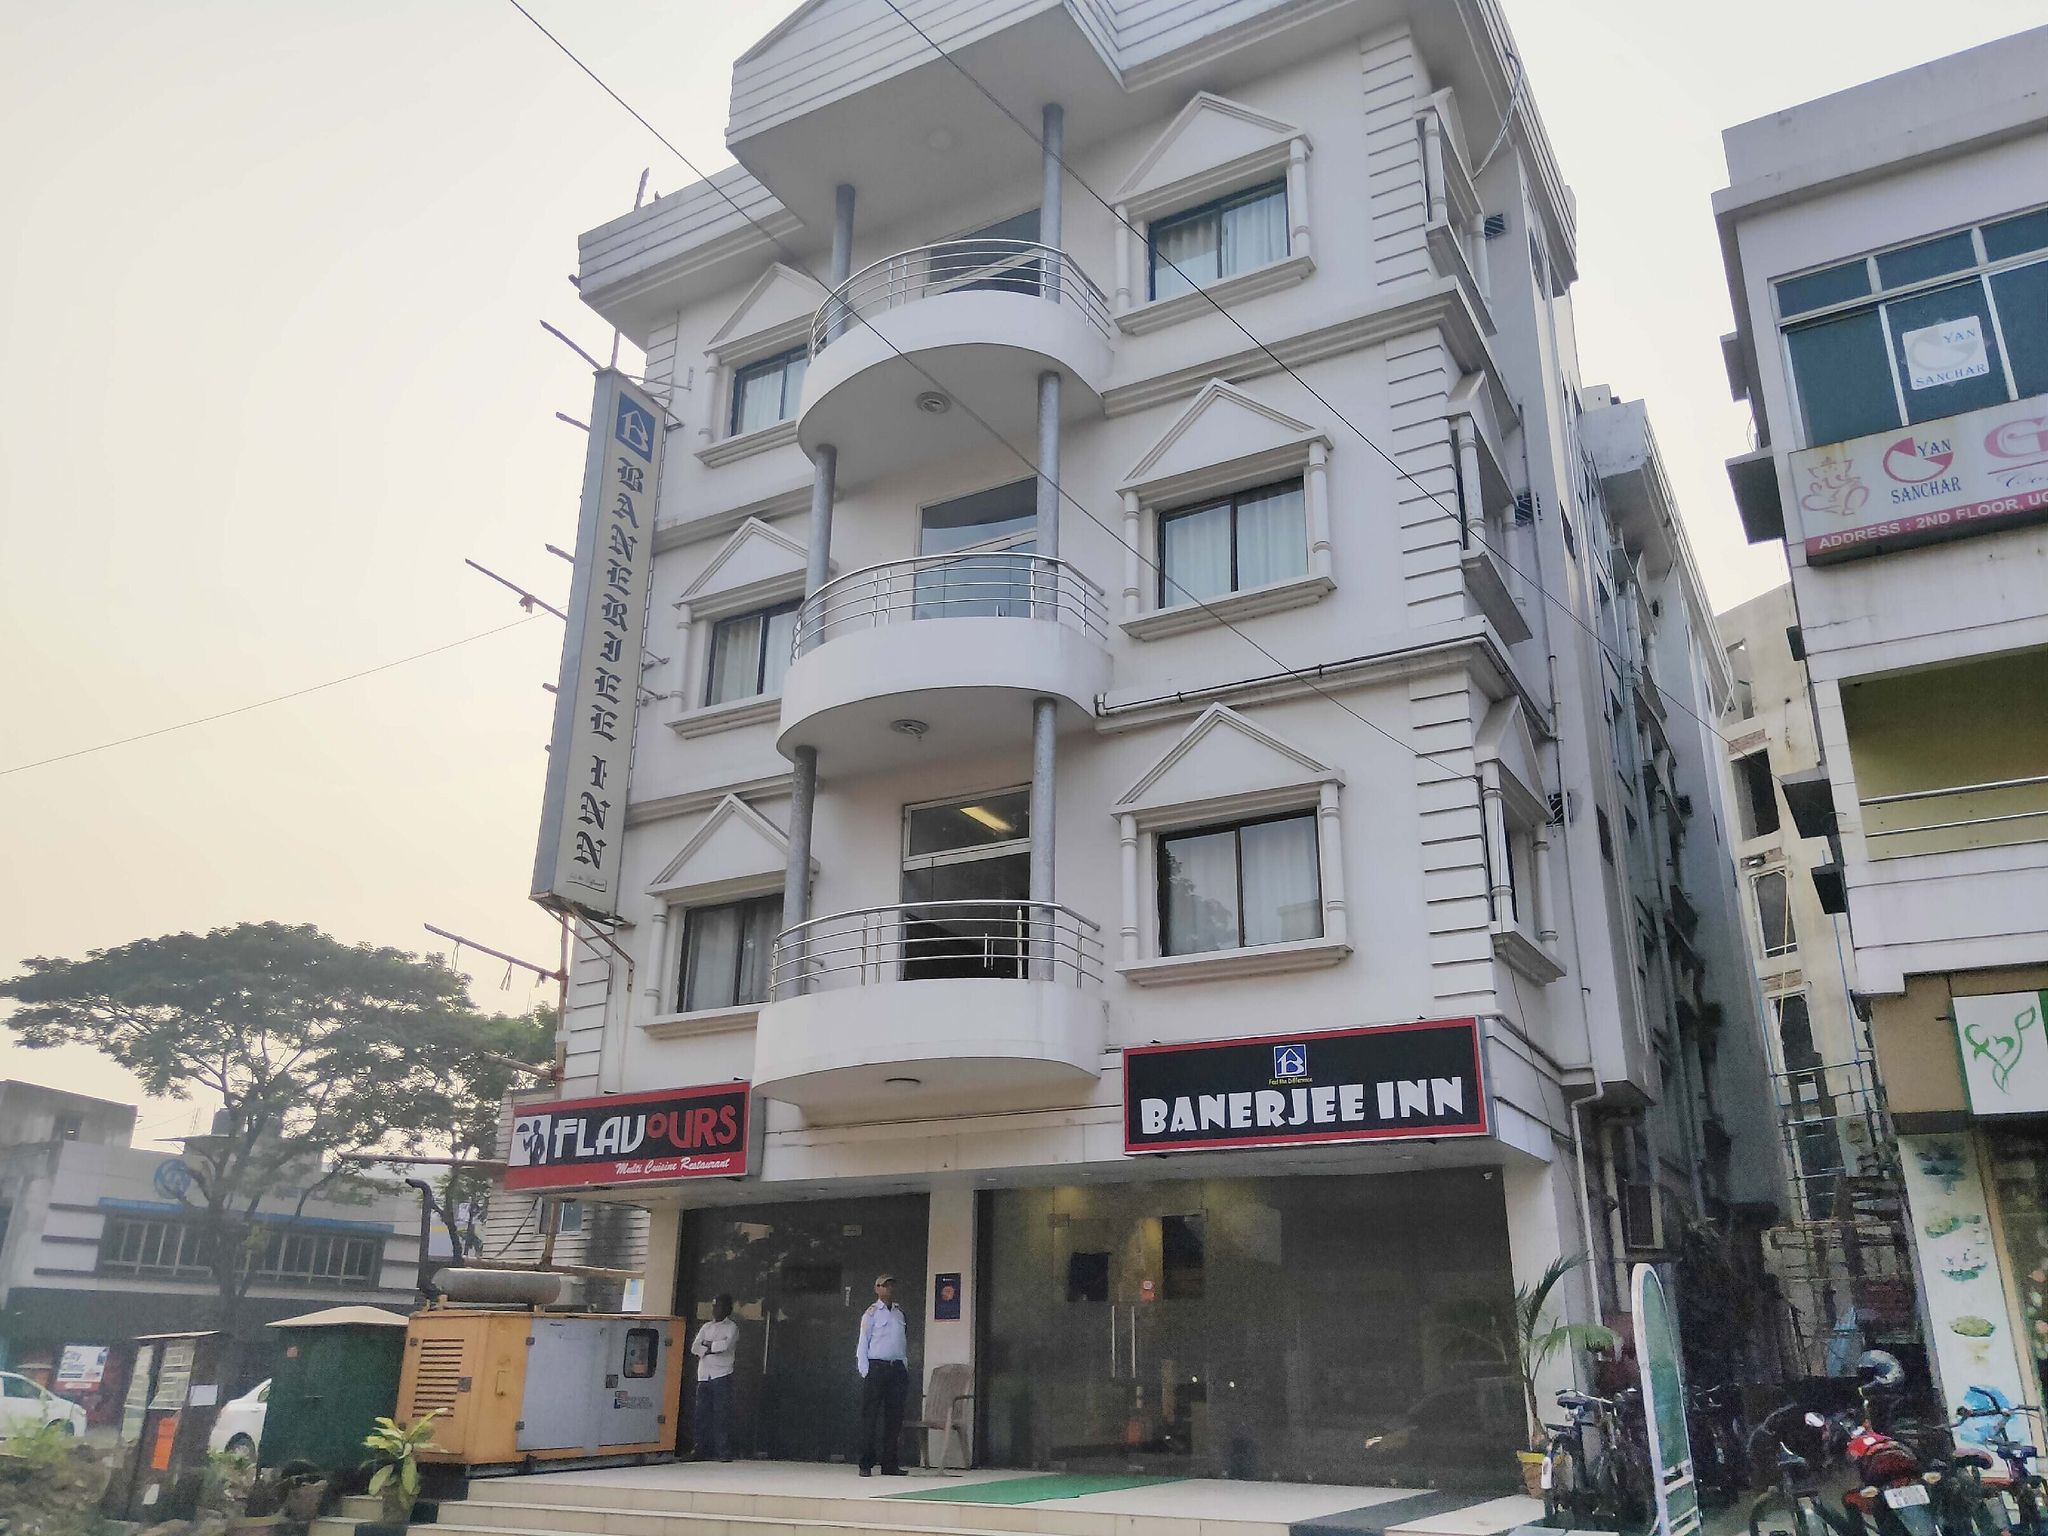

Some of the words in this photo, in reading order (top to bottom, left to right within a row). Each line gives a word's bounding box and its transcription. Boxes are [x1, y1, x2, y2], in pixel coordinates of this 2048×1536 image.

[1915, 363, 1986, 387] SANCHAR
[1890, 476, 1962, 505] SANCHAR
[1818, 522, 1901, 550] ADDRESS
[1916, 513, 1951, 528] 2ND
[573, 754, 612, 870] INN
[1140, 1084, 1365, 1135] BANERJEE
[1376, 1076, 1464, 1121] INN
[554, 1104, 738, 1159] FLAVOURS
[615, 1162, 641, 1175] Multi
[644, 1160, 677, 1174] Cuisine
[680, 1157, 731, 1170] Restaurant
